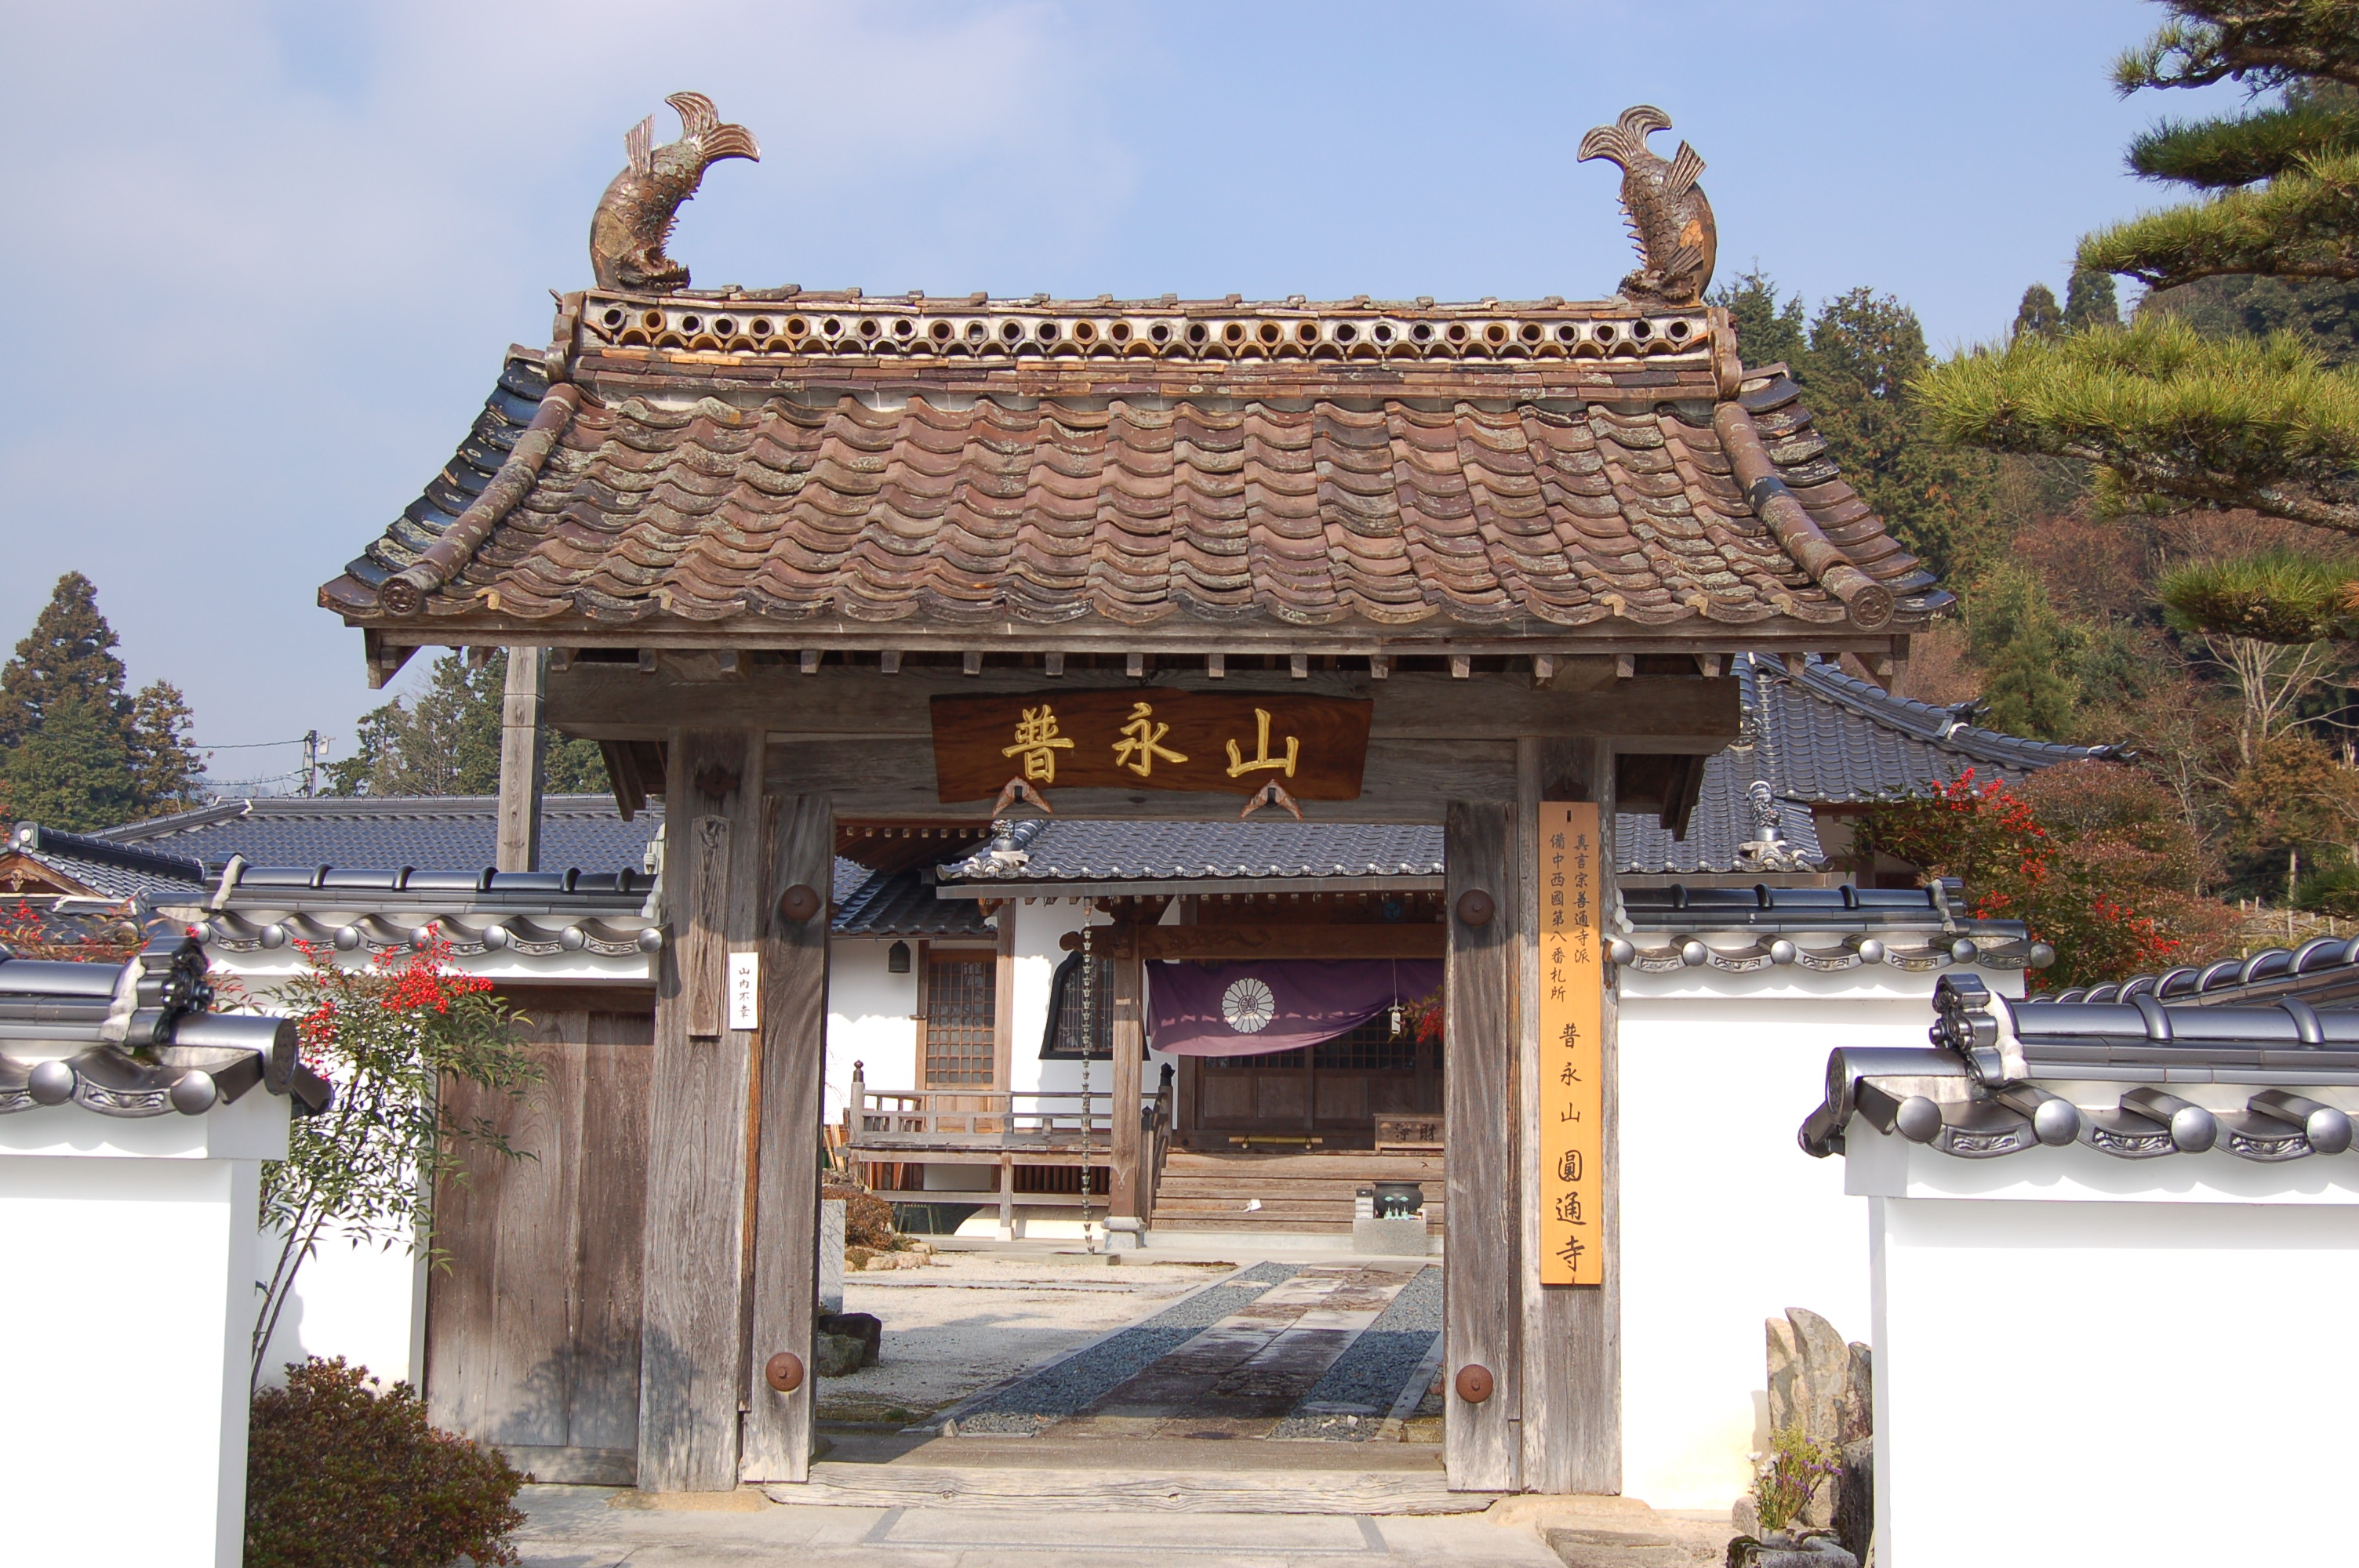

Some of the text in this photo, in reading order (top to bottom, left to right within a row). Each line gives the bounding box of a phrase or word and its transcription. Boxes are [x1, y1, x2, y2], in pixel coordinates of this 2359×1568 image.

[1002, 702, 1299, 783] 普永山
[1572, 833, 1590, 964] 真言宗善通寺派
[738, 967, 751, 1019] 山内不幸
[1555, 1023, 1587, 1272] 普永山 圓通寺
